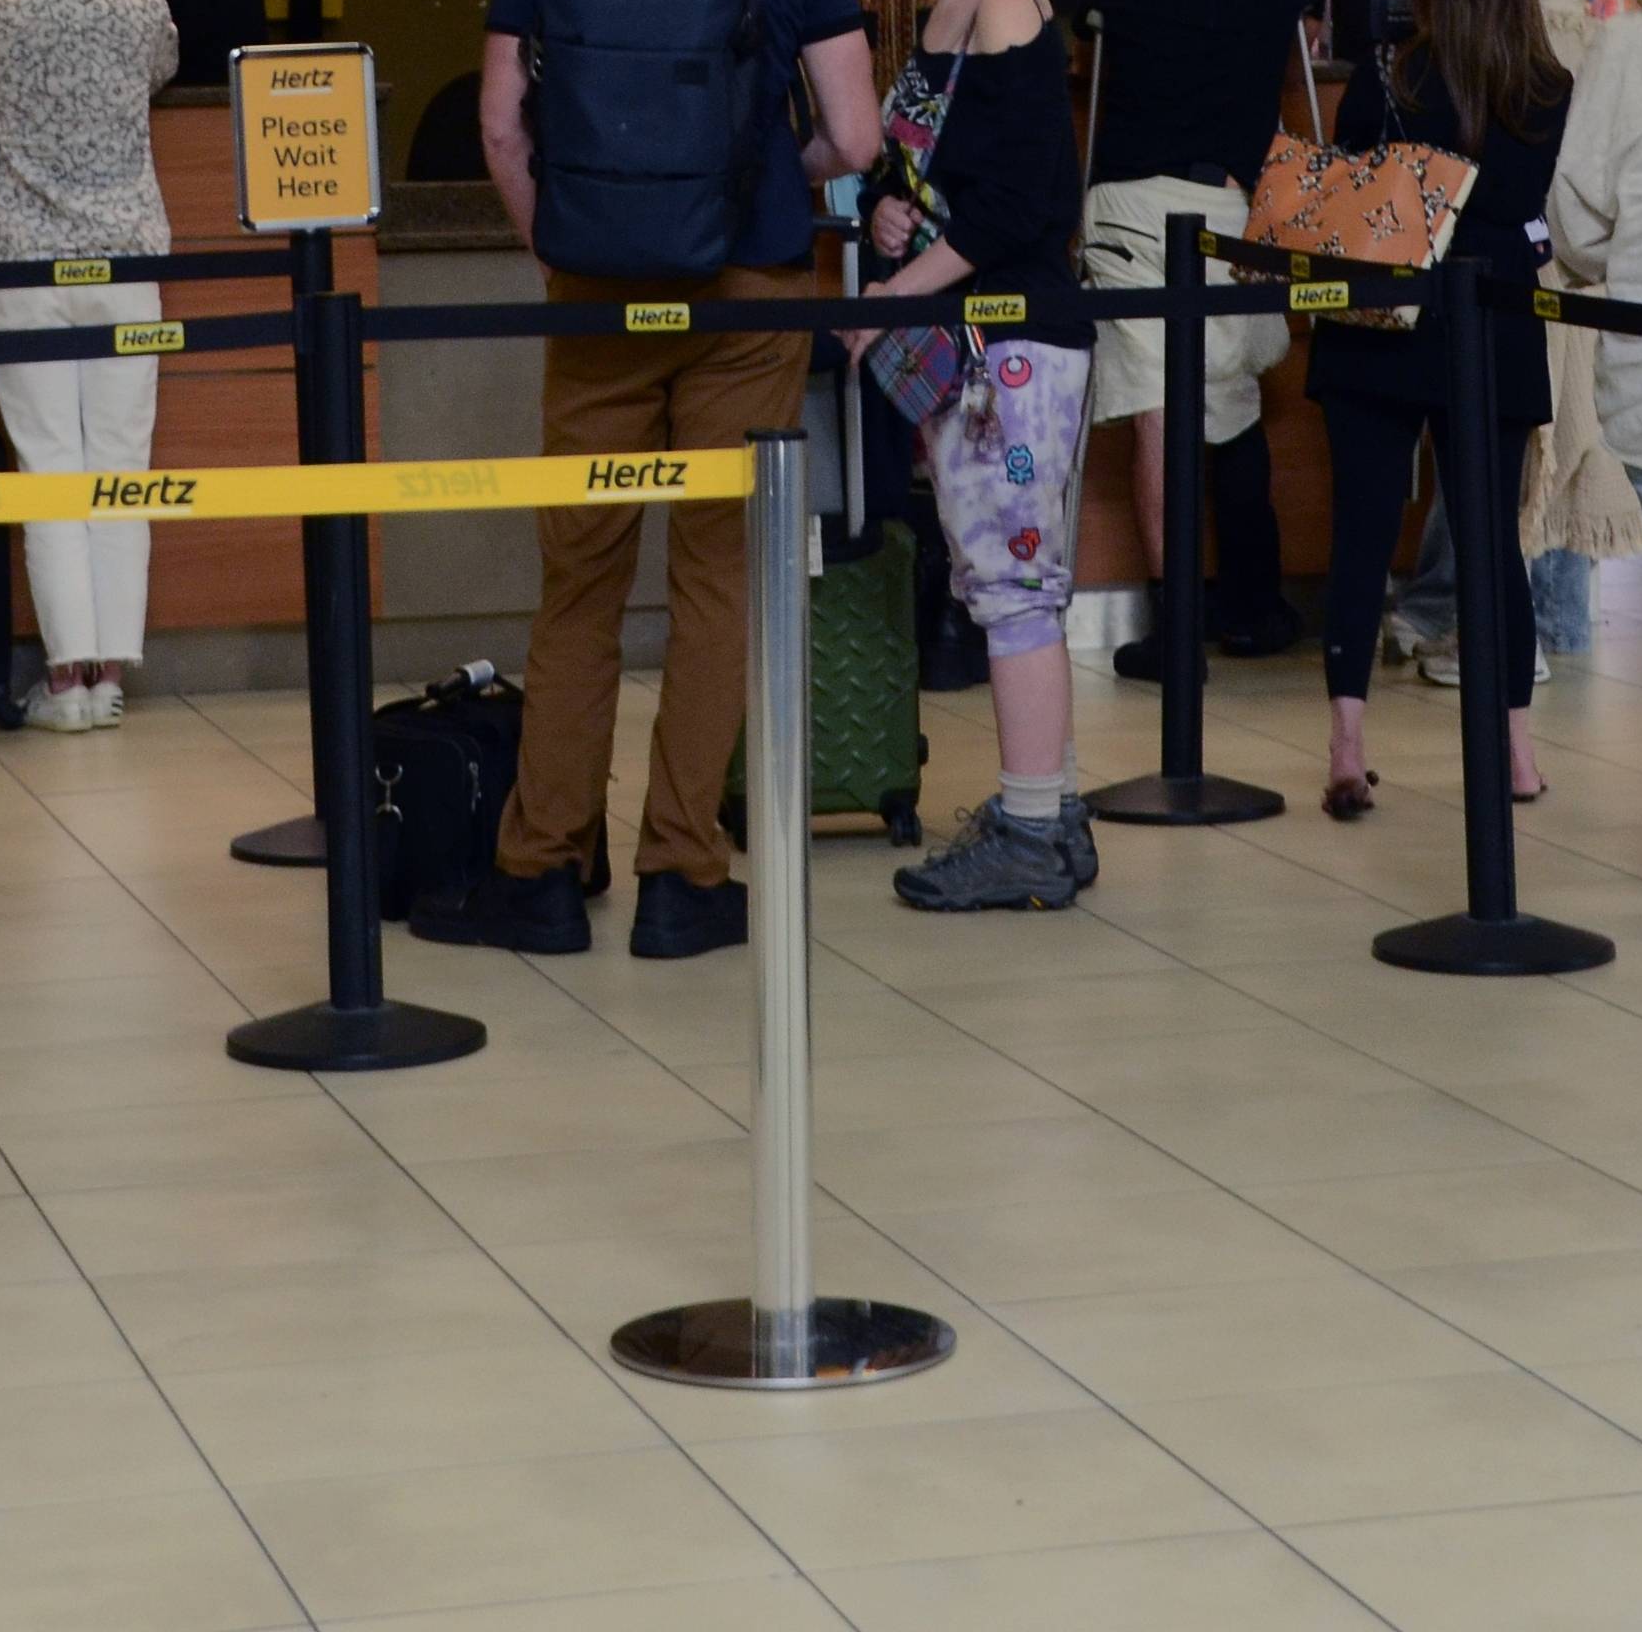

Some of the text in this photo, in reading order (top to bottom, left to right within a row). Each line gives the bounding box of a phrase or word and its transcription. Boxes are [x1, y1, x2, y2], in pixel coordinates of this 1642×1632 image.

[271, 68, 334, 90] Hertz
[262, 117, 348, 138] Please
[274, 145, 338, 167] Wait
[277, 175, 339, 198] Here
[58, 262, 106, 280] Hertz
[1295, 286, 1342, 305] Hertz
[631, 306, 684, 325] Hertz
[969, 299, 1023, 319] Hertz
[120, 325, 177, 347] Hertz
[587, 458, 688, 489] Hertz
[91, 475, 196, 508] Hertz
